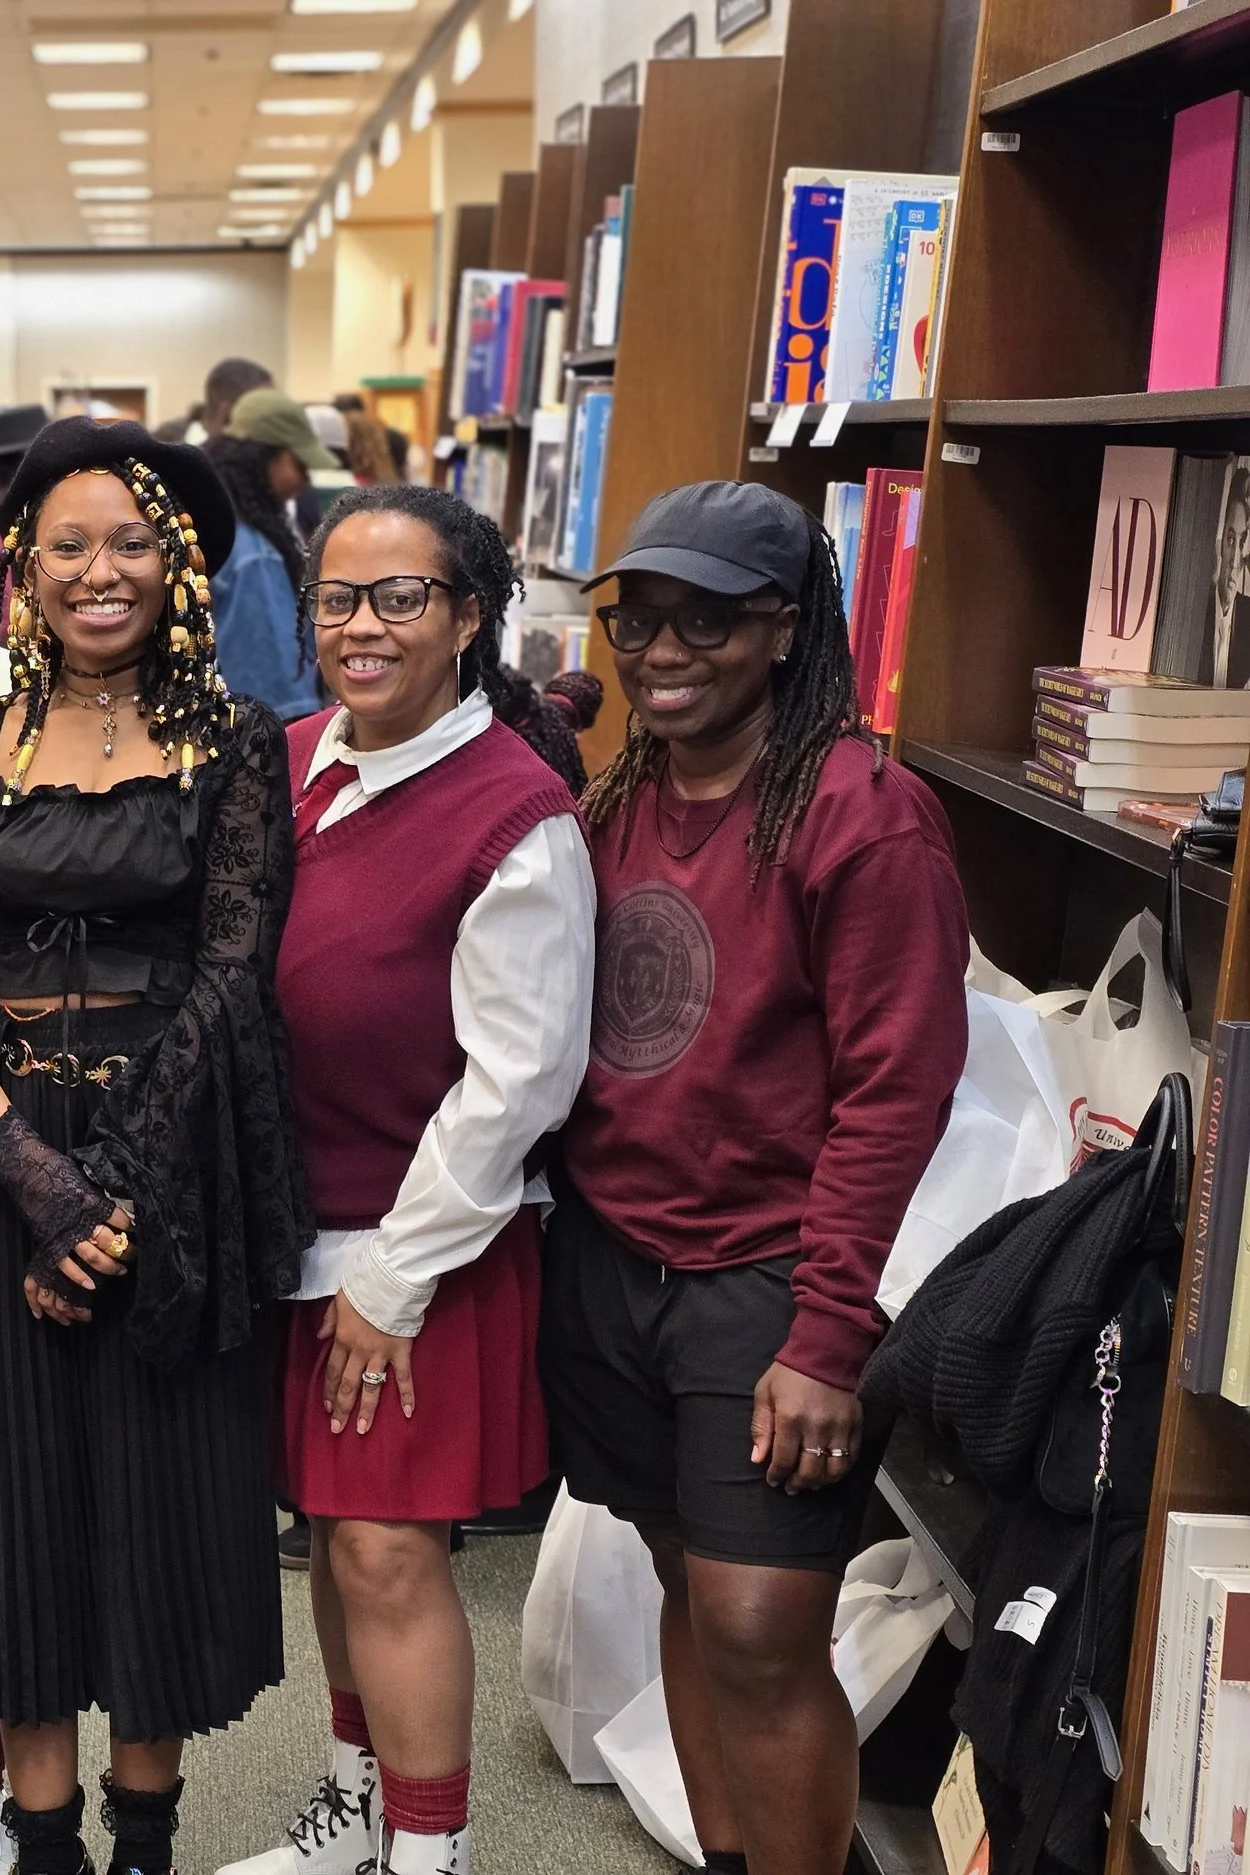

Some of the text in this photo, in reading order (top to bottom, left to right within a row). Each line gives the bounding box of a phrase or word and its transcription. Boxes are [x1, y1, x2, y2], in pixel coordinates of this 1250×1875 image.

[919, 241, 936, 256] 10
[1088, 497, 1158, 640] AD
[1185, 1076, 1225, 1337] COLOR PATTERN TEXTURE
[1189, 1598, 1198, 1636] House
[1154, 1632, 1167, 1721] Remodelista
[1186, 1649, 1195, 1679] Love
[1201, 1600, 1223, 1771] DREAM HOME DIY
[1182, 1690, 1191, 1726] Home
